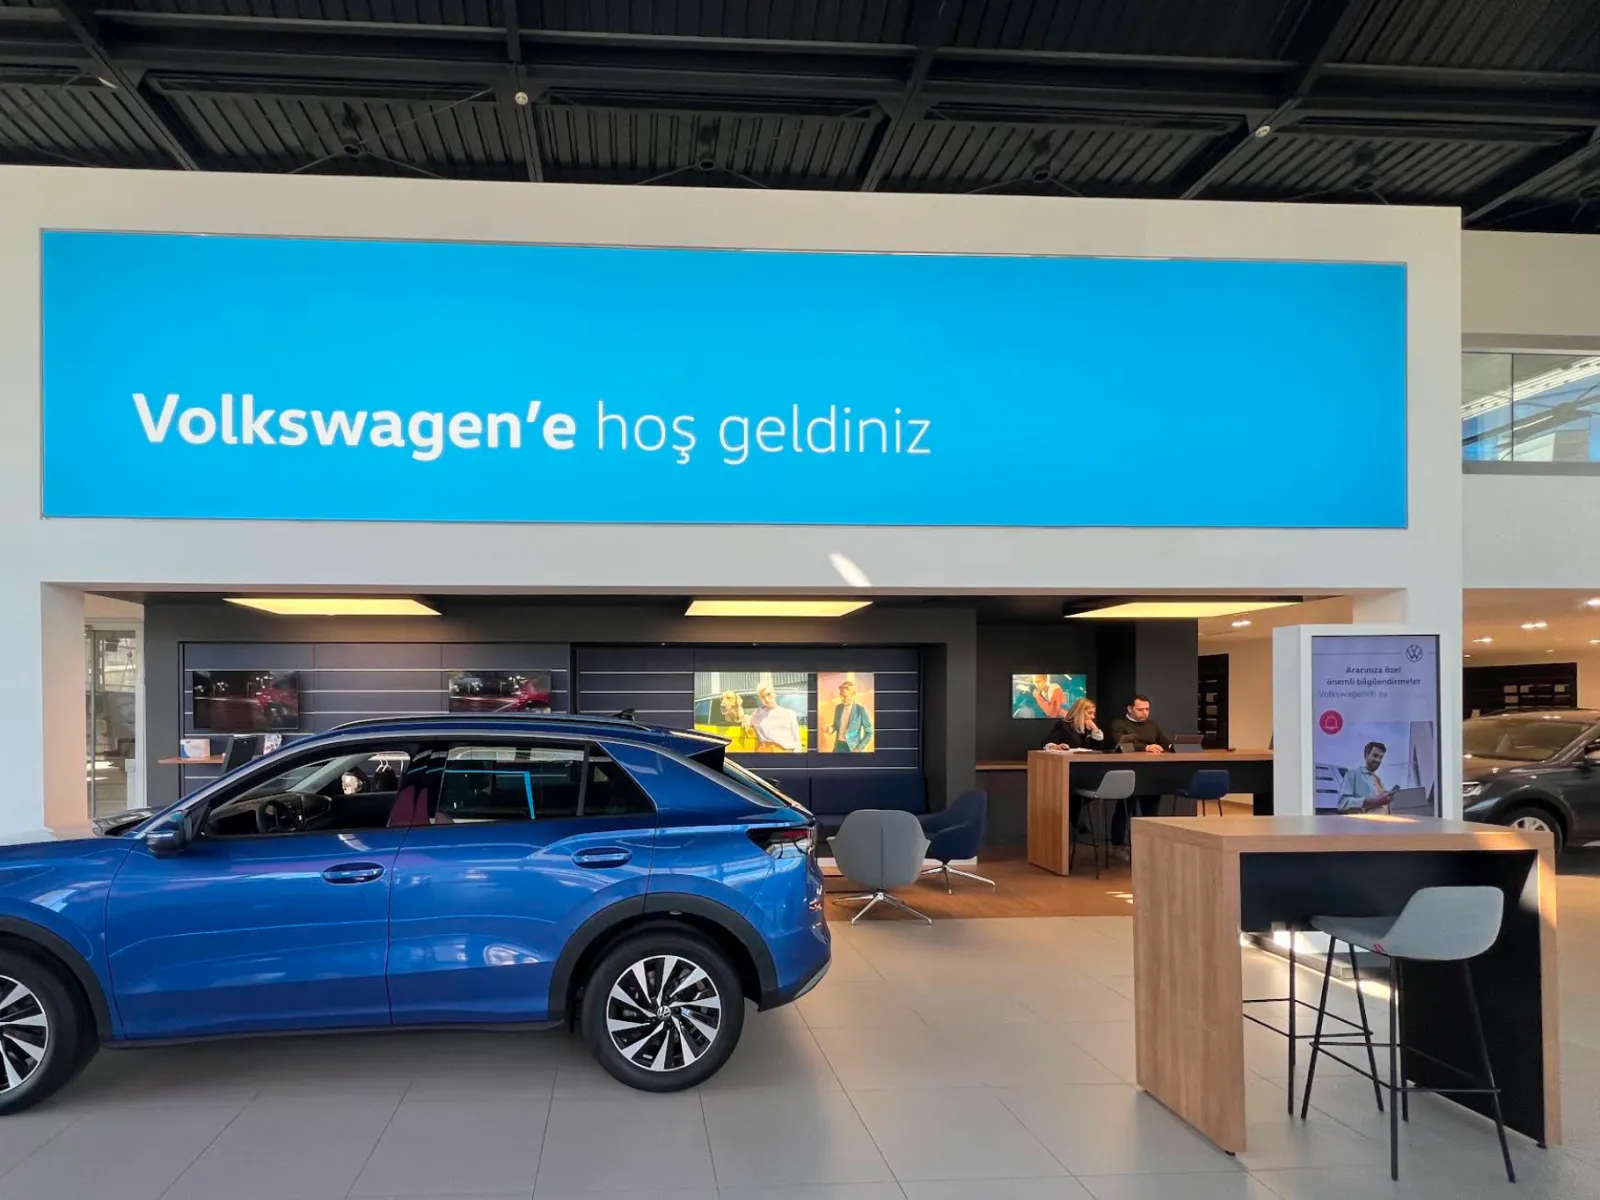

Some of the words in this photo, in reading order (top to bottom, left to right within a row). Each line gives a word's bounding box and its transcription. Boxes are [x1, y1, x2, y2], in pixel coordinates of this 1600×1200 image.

[597, 400, 698, 466] hoş
[718, 403, 933, 467] geldiniz
[1384, 665, 1402, 674] özel
[1326, 677, 1356, 685] önemli
[1356, 677, 1421, 687] bilgilendirmeler
